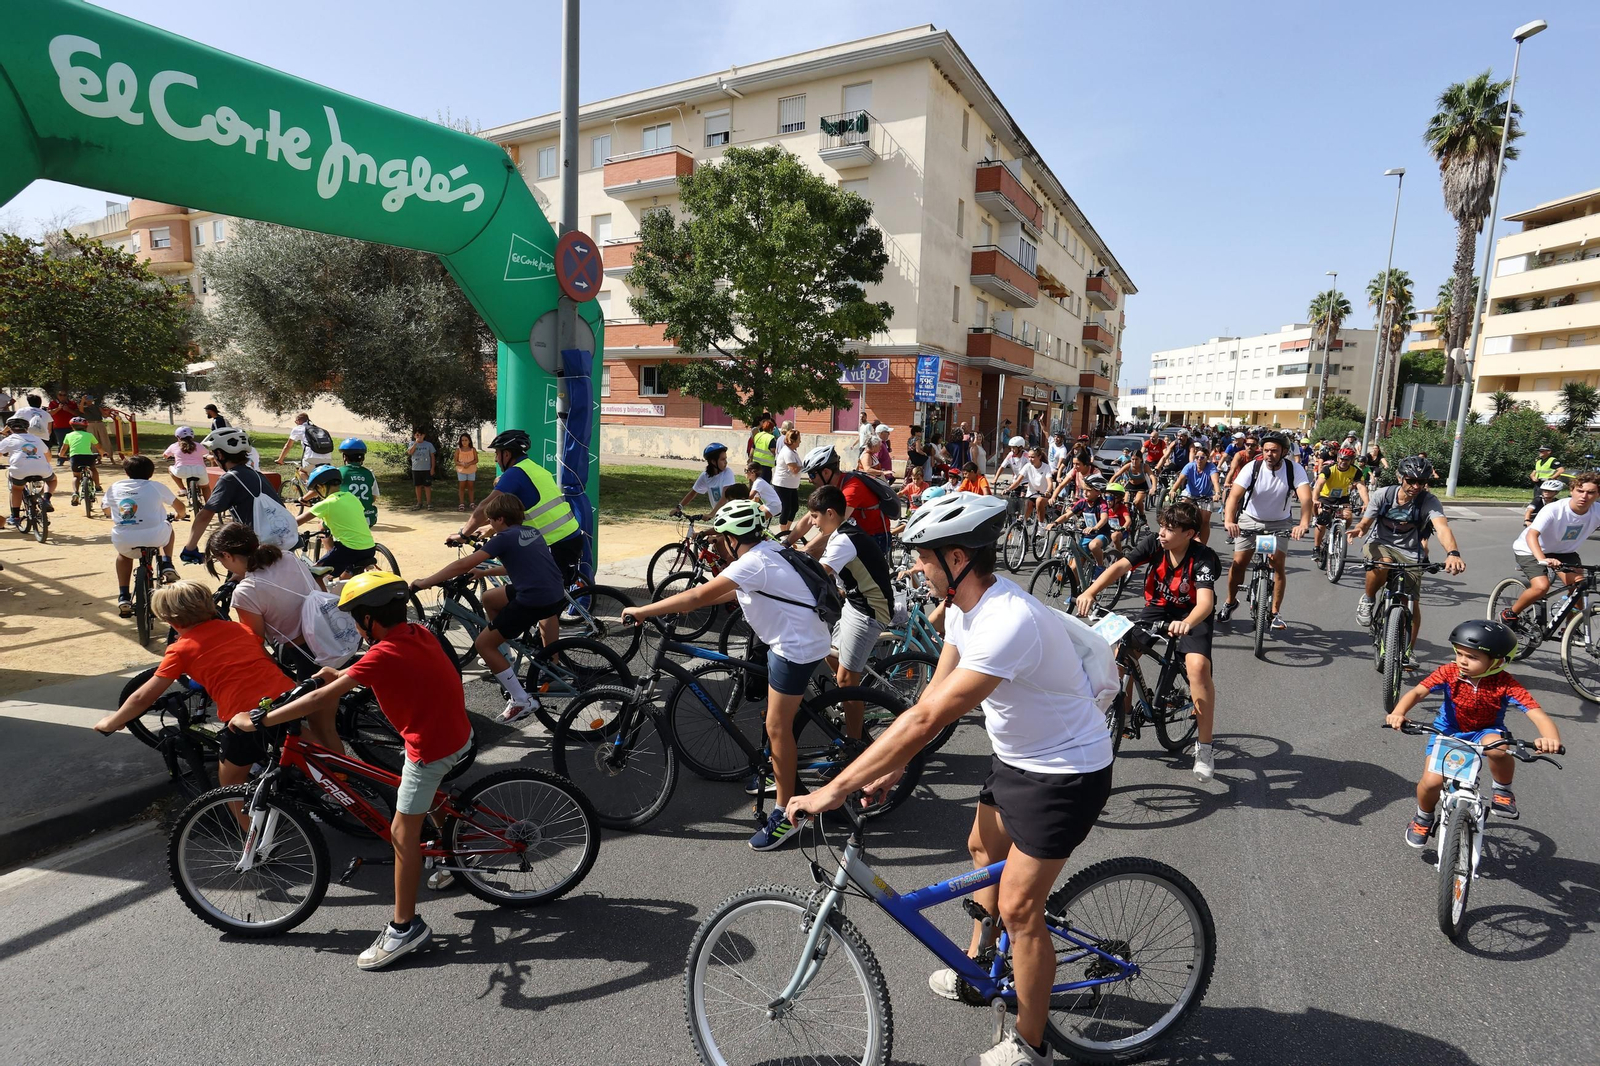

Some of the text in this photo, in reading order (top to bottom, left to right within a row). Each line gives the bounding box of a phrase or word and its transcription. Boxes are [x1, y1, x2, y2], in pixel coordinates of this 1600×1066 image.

[49, 34, 485, 212] El Corte Inglés
[512, 253, 555, 272] El Corte Ingl
[868, 367, 883, 382] B2
[348, 483, 369, 500] 22
[520, 528, 537, 539] NIKE
[1196, 573, 1216, 582] MSC
